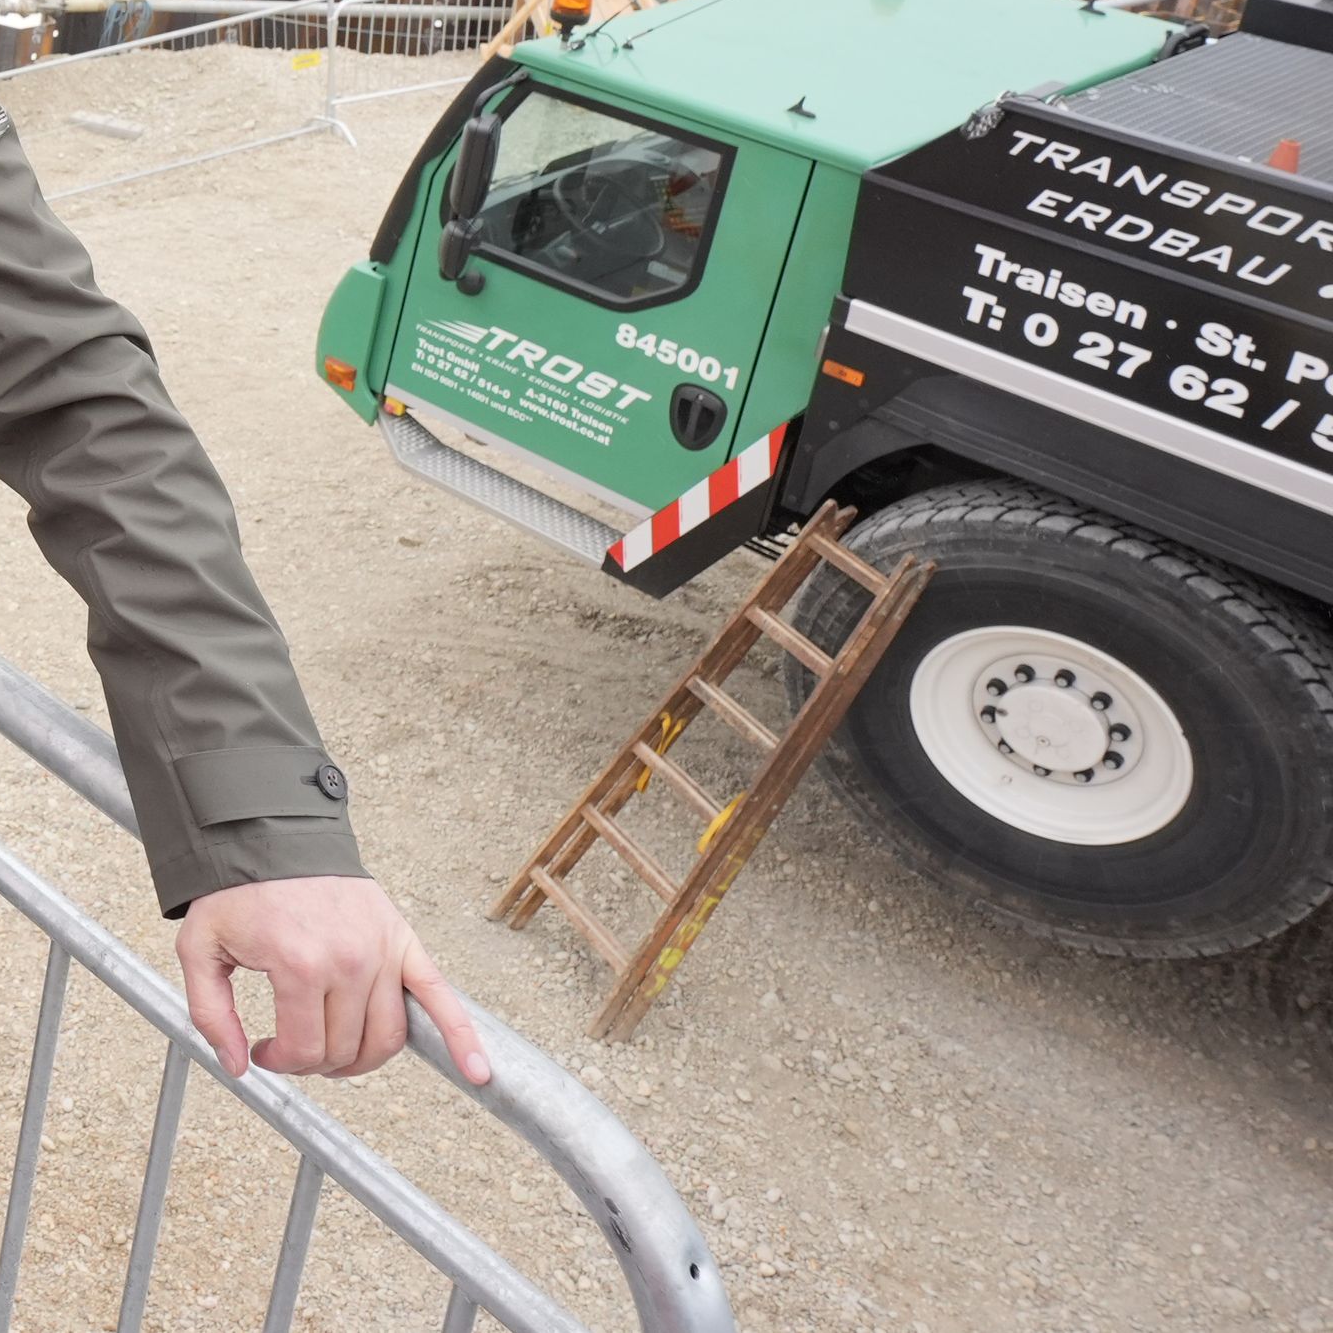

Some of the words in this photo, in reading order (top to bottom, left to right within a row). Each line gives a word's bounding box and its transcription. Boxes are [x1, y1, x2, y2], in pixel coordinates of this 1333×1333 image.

[1009, 130, 1333, 252] TRANSPOR
[1027, 189, 1292, 286] ERDBAU
[974, 243, 1148, 330] Traisen
[1195, 322, 1267, 372] St.
[415, 323, 476, 355] TRANSPORTE
[528, 374, 570, 399] ERDBAU
[580, 398, 629, 425] LOGISTIK
[417, 337, 445, 357] Trost
[446, 350, 480, 373] GmbH
[424, 369, 439, 381] ISO
[490, 400, 507, 415] und
[436, 357, 450, 372] 27
[453, 366, 468, 380] 62
[485, 326, 652, 410] TROST
[615, 323, 739, 390] 845001
[962, 286, 1007, 331] T:
[1023, 312, 1059, 347] 0
[1073, 331, 1153, 379] 27
[1169, 364, 1250, 419] 62
[1261, 399, 1301, 430] /
[519, 398, 611, 447] www.trost.co.at
[525, 388, 568, 413] A-3160
[571, 407, 613, 435] Traisen
